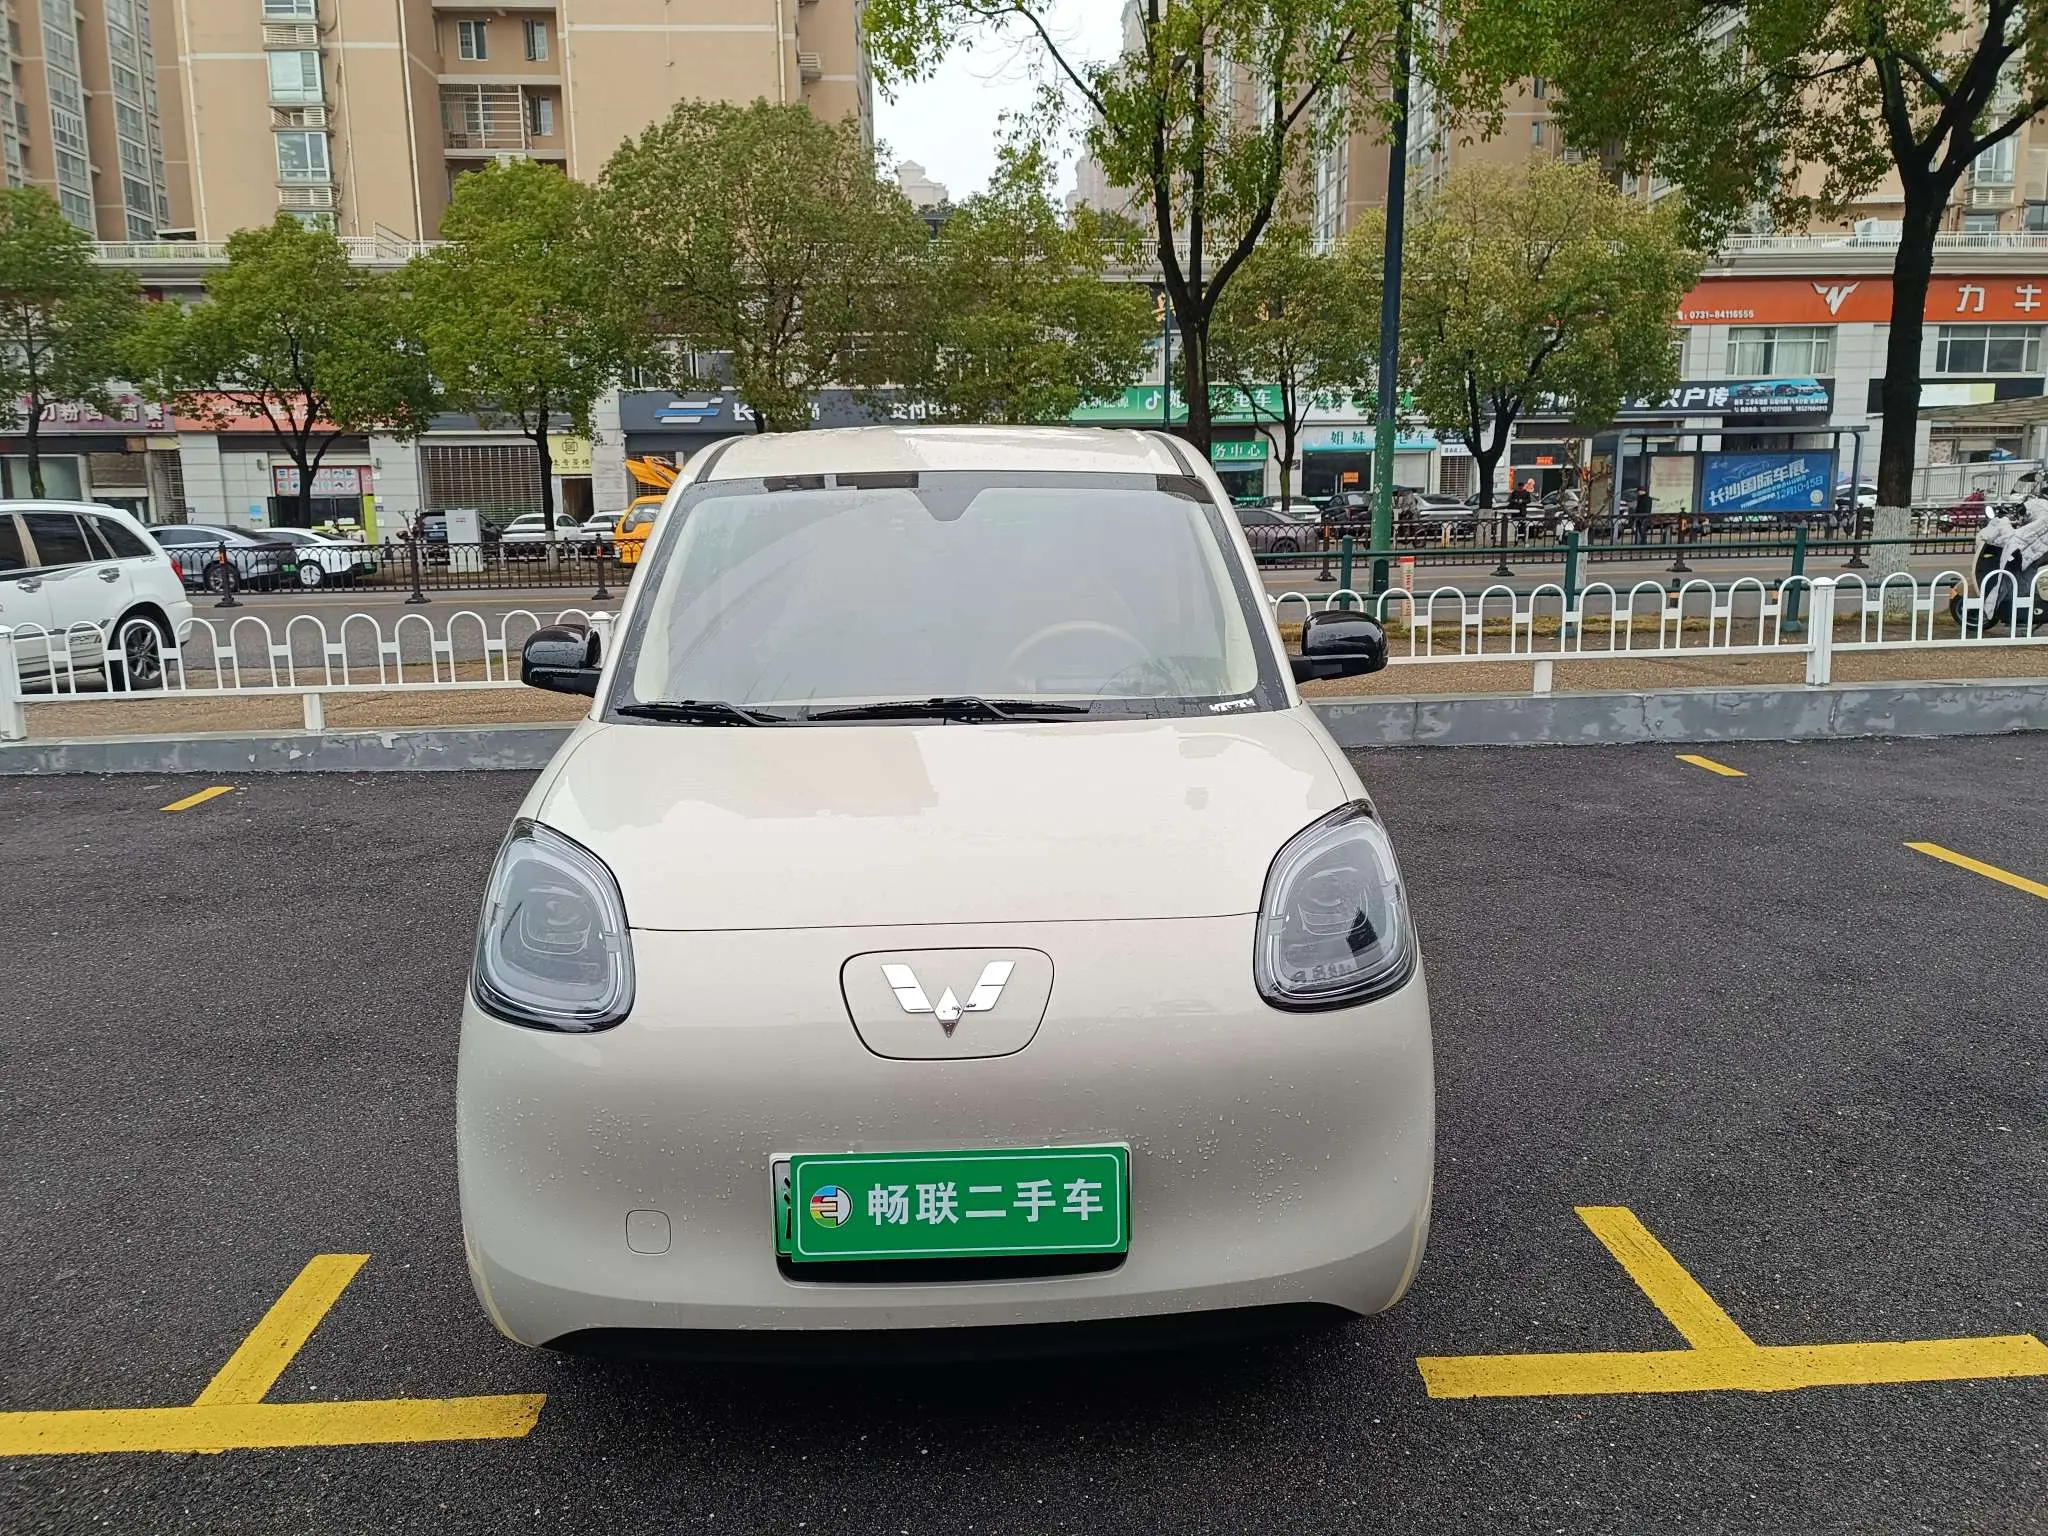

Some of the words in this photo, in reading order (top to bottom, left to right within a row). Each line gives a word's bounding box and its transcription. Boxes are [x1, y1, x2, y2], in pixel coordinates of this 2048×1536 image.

[867, 1177, 1104, 1226] 畅联二手车
